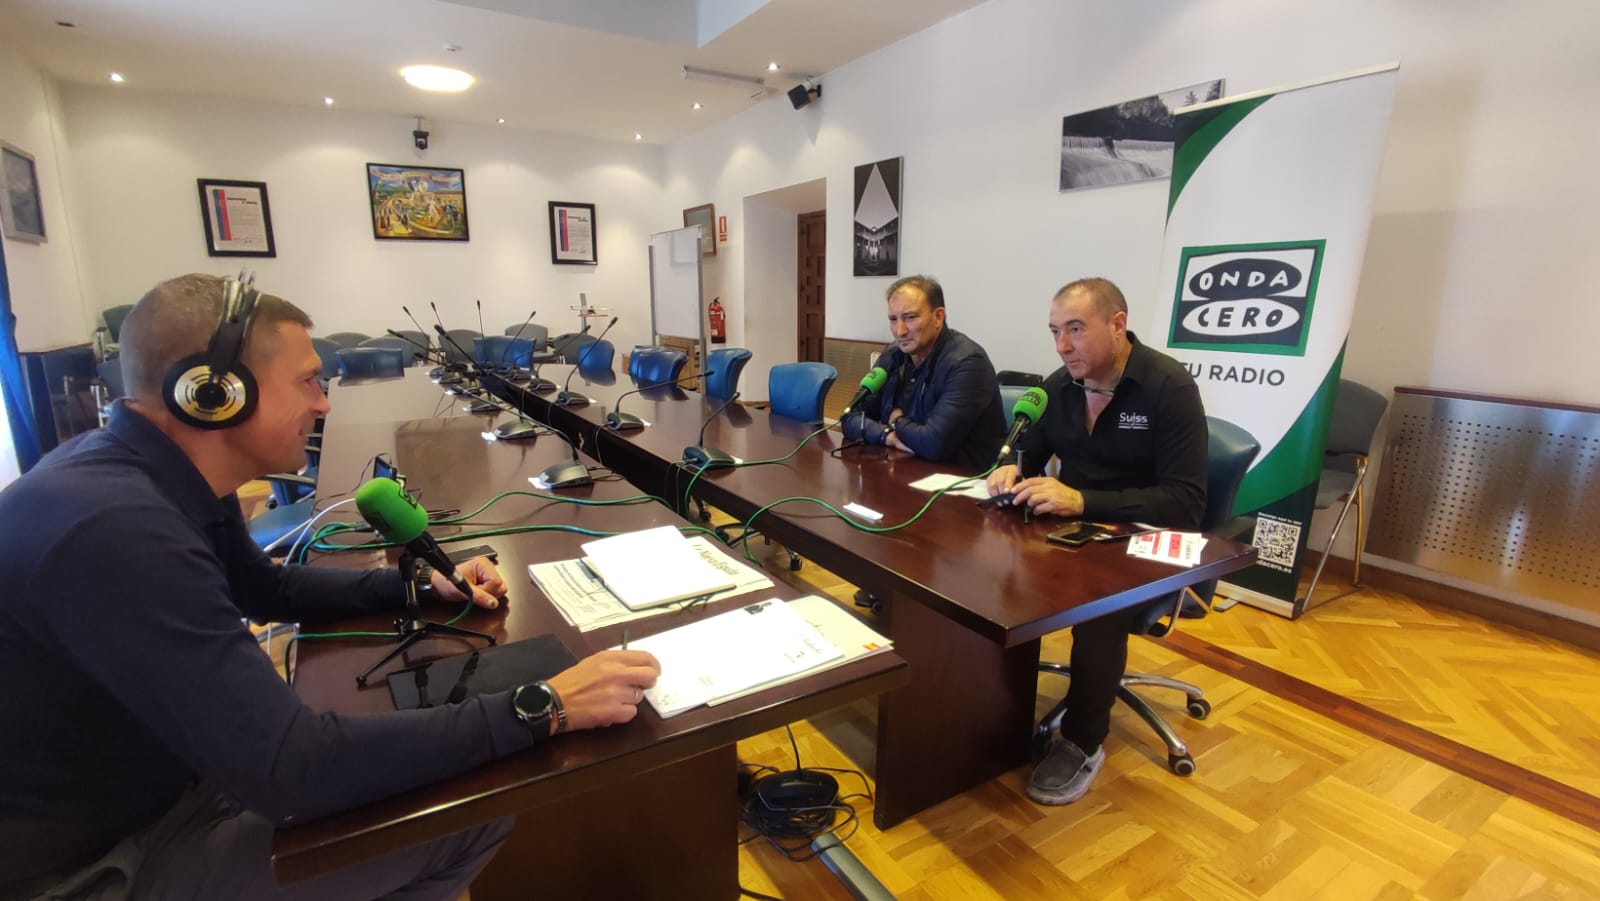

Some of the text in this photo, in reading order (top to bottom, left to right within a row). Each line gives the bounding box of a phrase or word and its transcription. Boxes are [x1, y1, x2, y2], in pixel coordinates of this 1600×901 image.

[1199, 269, 1289, 291] ONDA
[1197, 306, 1284, 328] CERO
[1208, 364, 1286, 387] RADIO
